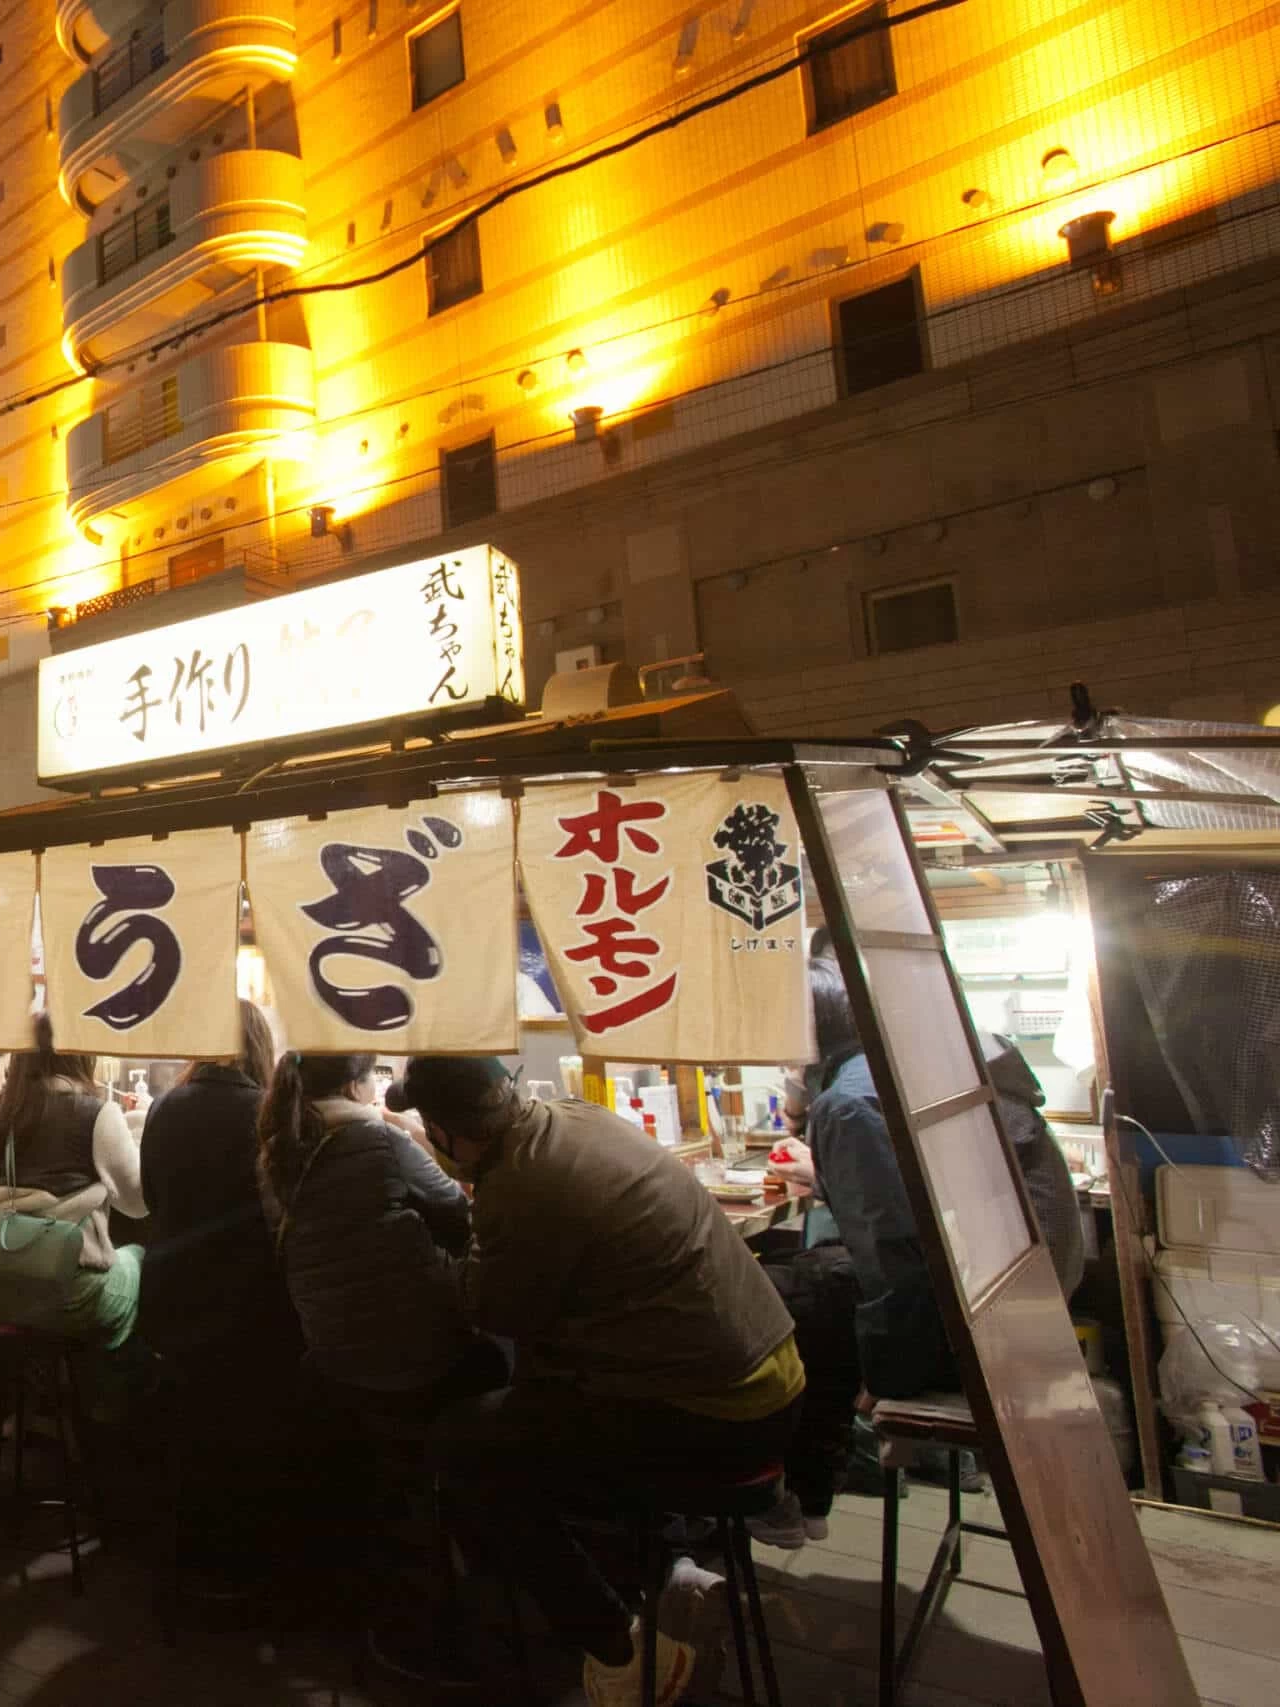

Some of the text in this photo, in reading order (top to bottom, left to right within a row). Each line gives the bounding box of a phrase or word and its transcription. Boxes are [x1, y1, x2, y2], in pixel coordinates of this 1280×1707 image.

[118, 643, 251, 742] 手作り
[420, 560, 468, 704] 武ちゃん
[554, 790, 678, 1034] ホルモン
[730, 937, 796, 951] しげます
